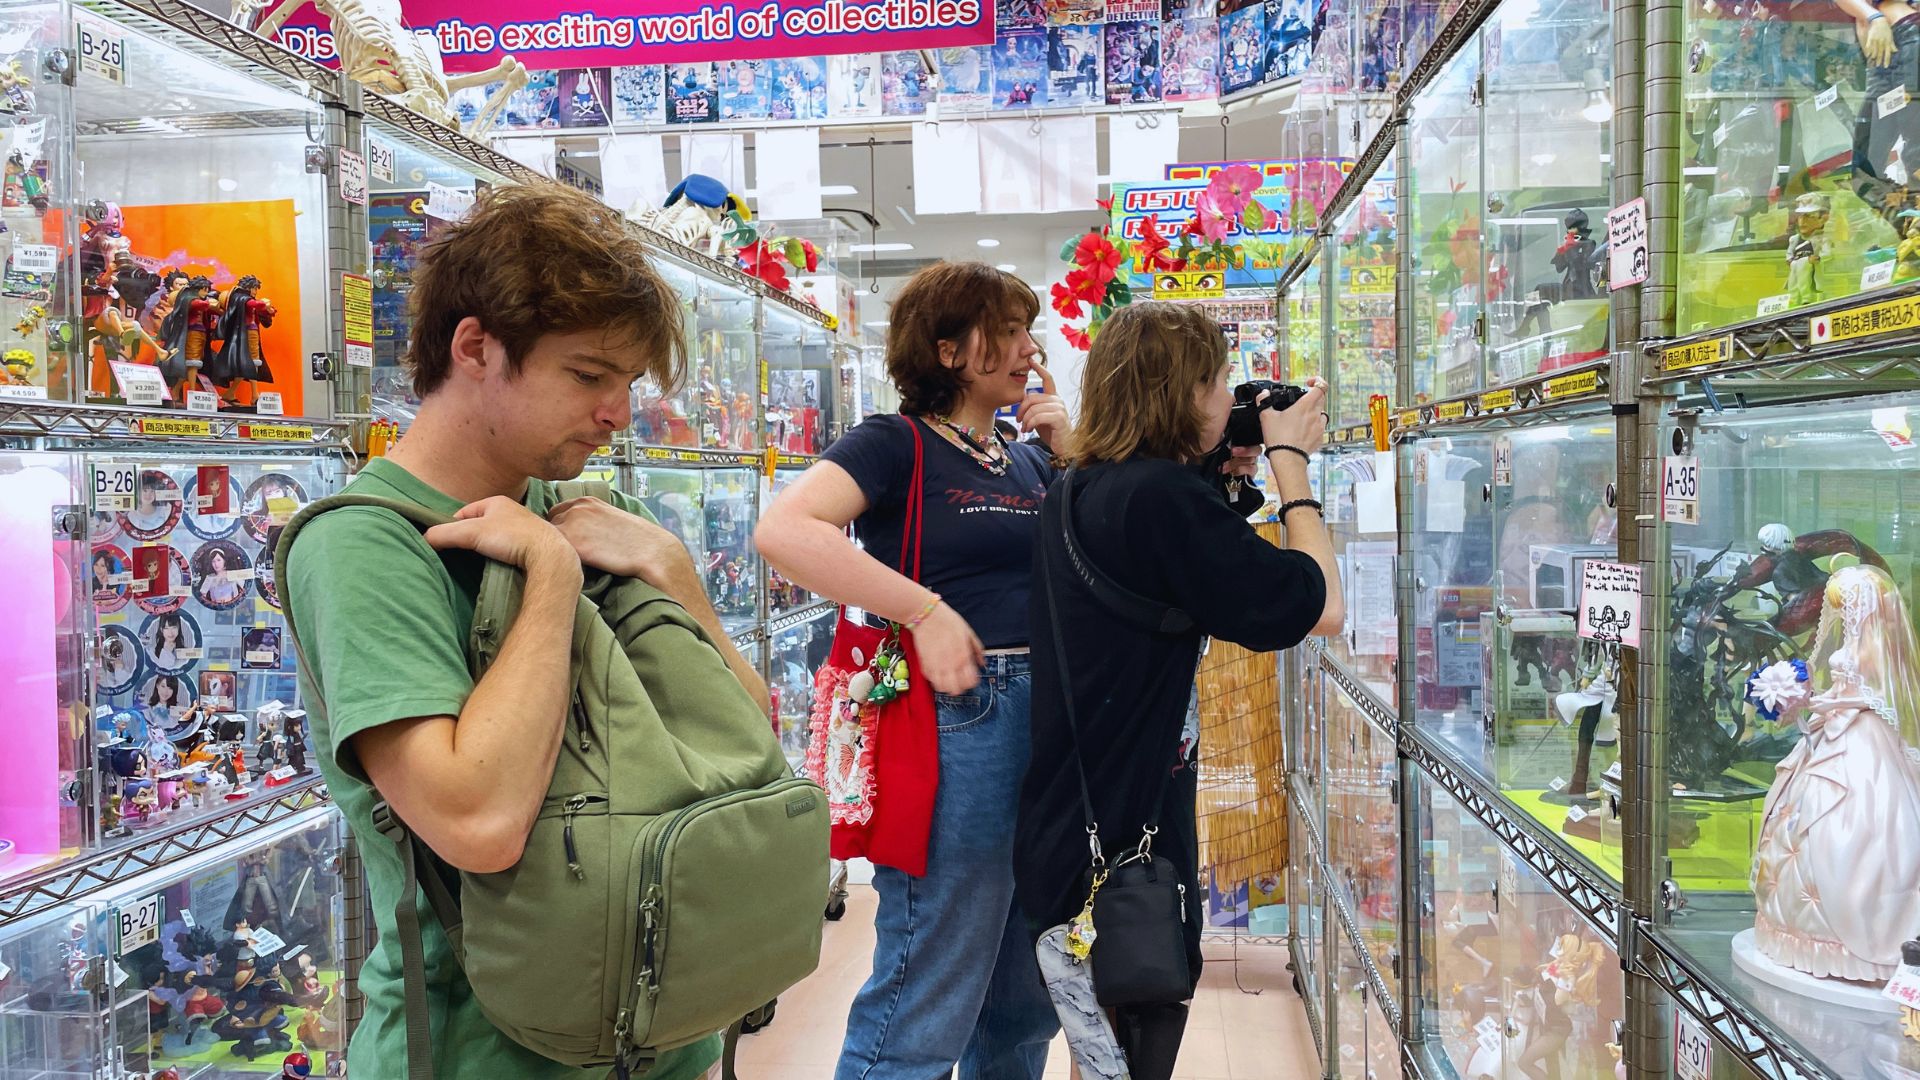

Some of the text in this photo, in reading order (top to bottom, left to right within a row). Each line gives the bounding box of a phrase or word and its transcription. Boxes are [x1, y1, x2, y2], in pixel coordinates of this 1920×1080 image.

[1106, 2, 1159, 14] THE THIRD
[1106, 11, 1159, 21] DETECTIVE
[440, 21, 492, 52] the
[501, 13, 632, 50] exciting
[639, 15, 732, 41] world
[740, 6, 777, 38] of
[784, 0, 978, 34] collectibles
[82, 31, 120, 65] B-25
[371, 145, 392, 169] B-21
[145, 423, 201, 433] 商品购买流程
[96, 470, 134, 493] B-26
[1665, 466, 1696, 497] A-35
[960, 506, 987, 514] LOVE
[1586, 562, 1594, 570] If
[1596, 563, 1606, 571] the
[1594, 582, 1609, 591] with
[121, 901, 157, 937] B-27
[1678, 1023, 1707, 1073] A-37
